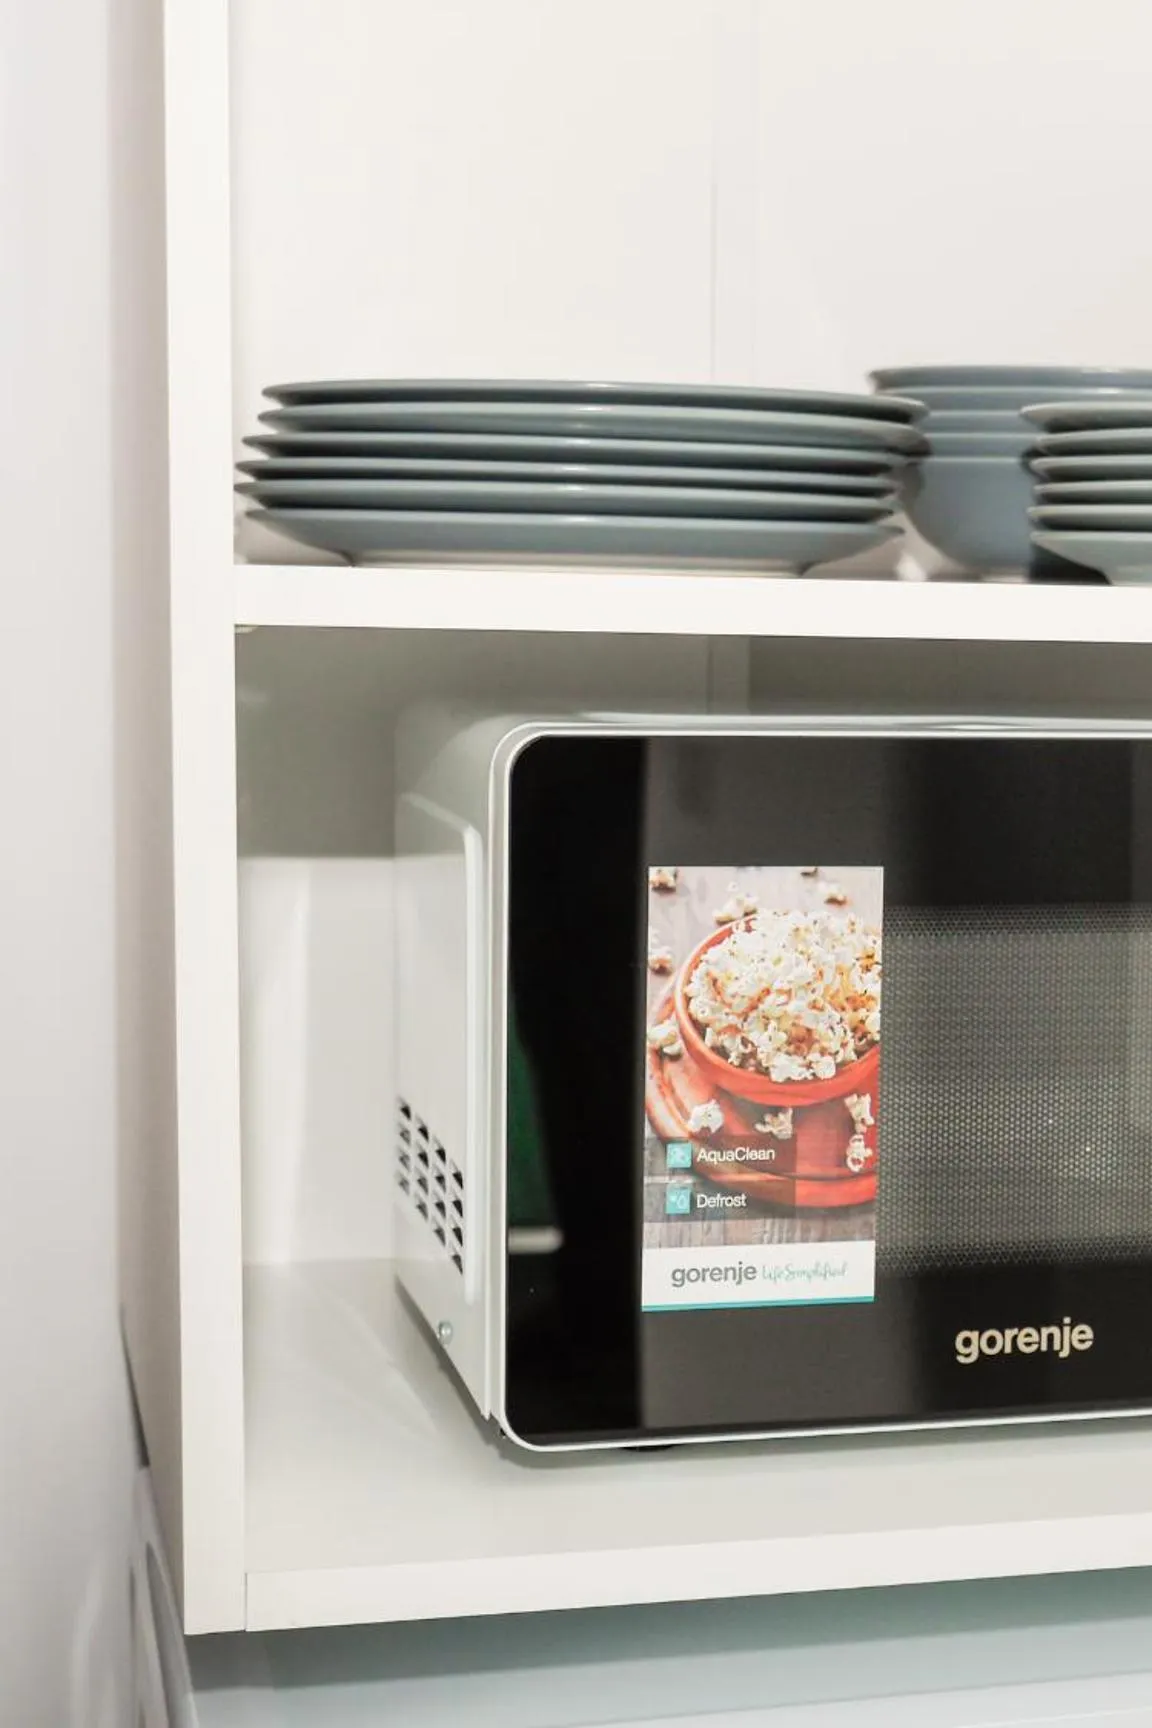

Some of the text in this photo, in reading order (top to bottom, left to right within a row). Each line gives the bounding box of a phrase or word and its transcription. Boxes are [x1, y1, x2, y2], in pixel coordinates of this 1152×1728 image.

[696, 1146, 776, 1163] AquaClean
[696, 1192, 747, 1209] Defrost
[671, 1260, 758, 1288] gorenje
[954, 1316, 1095, 1365] gorenje
